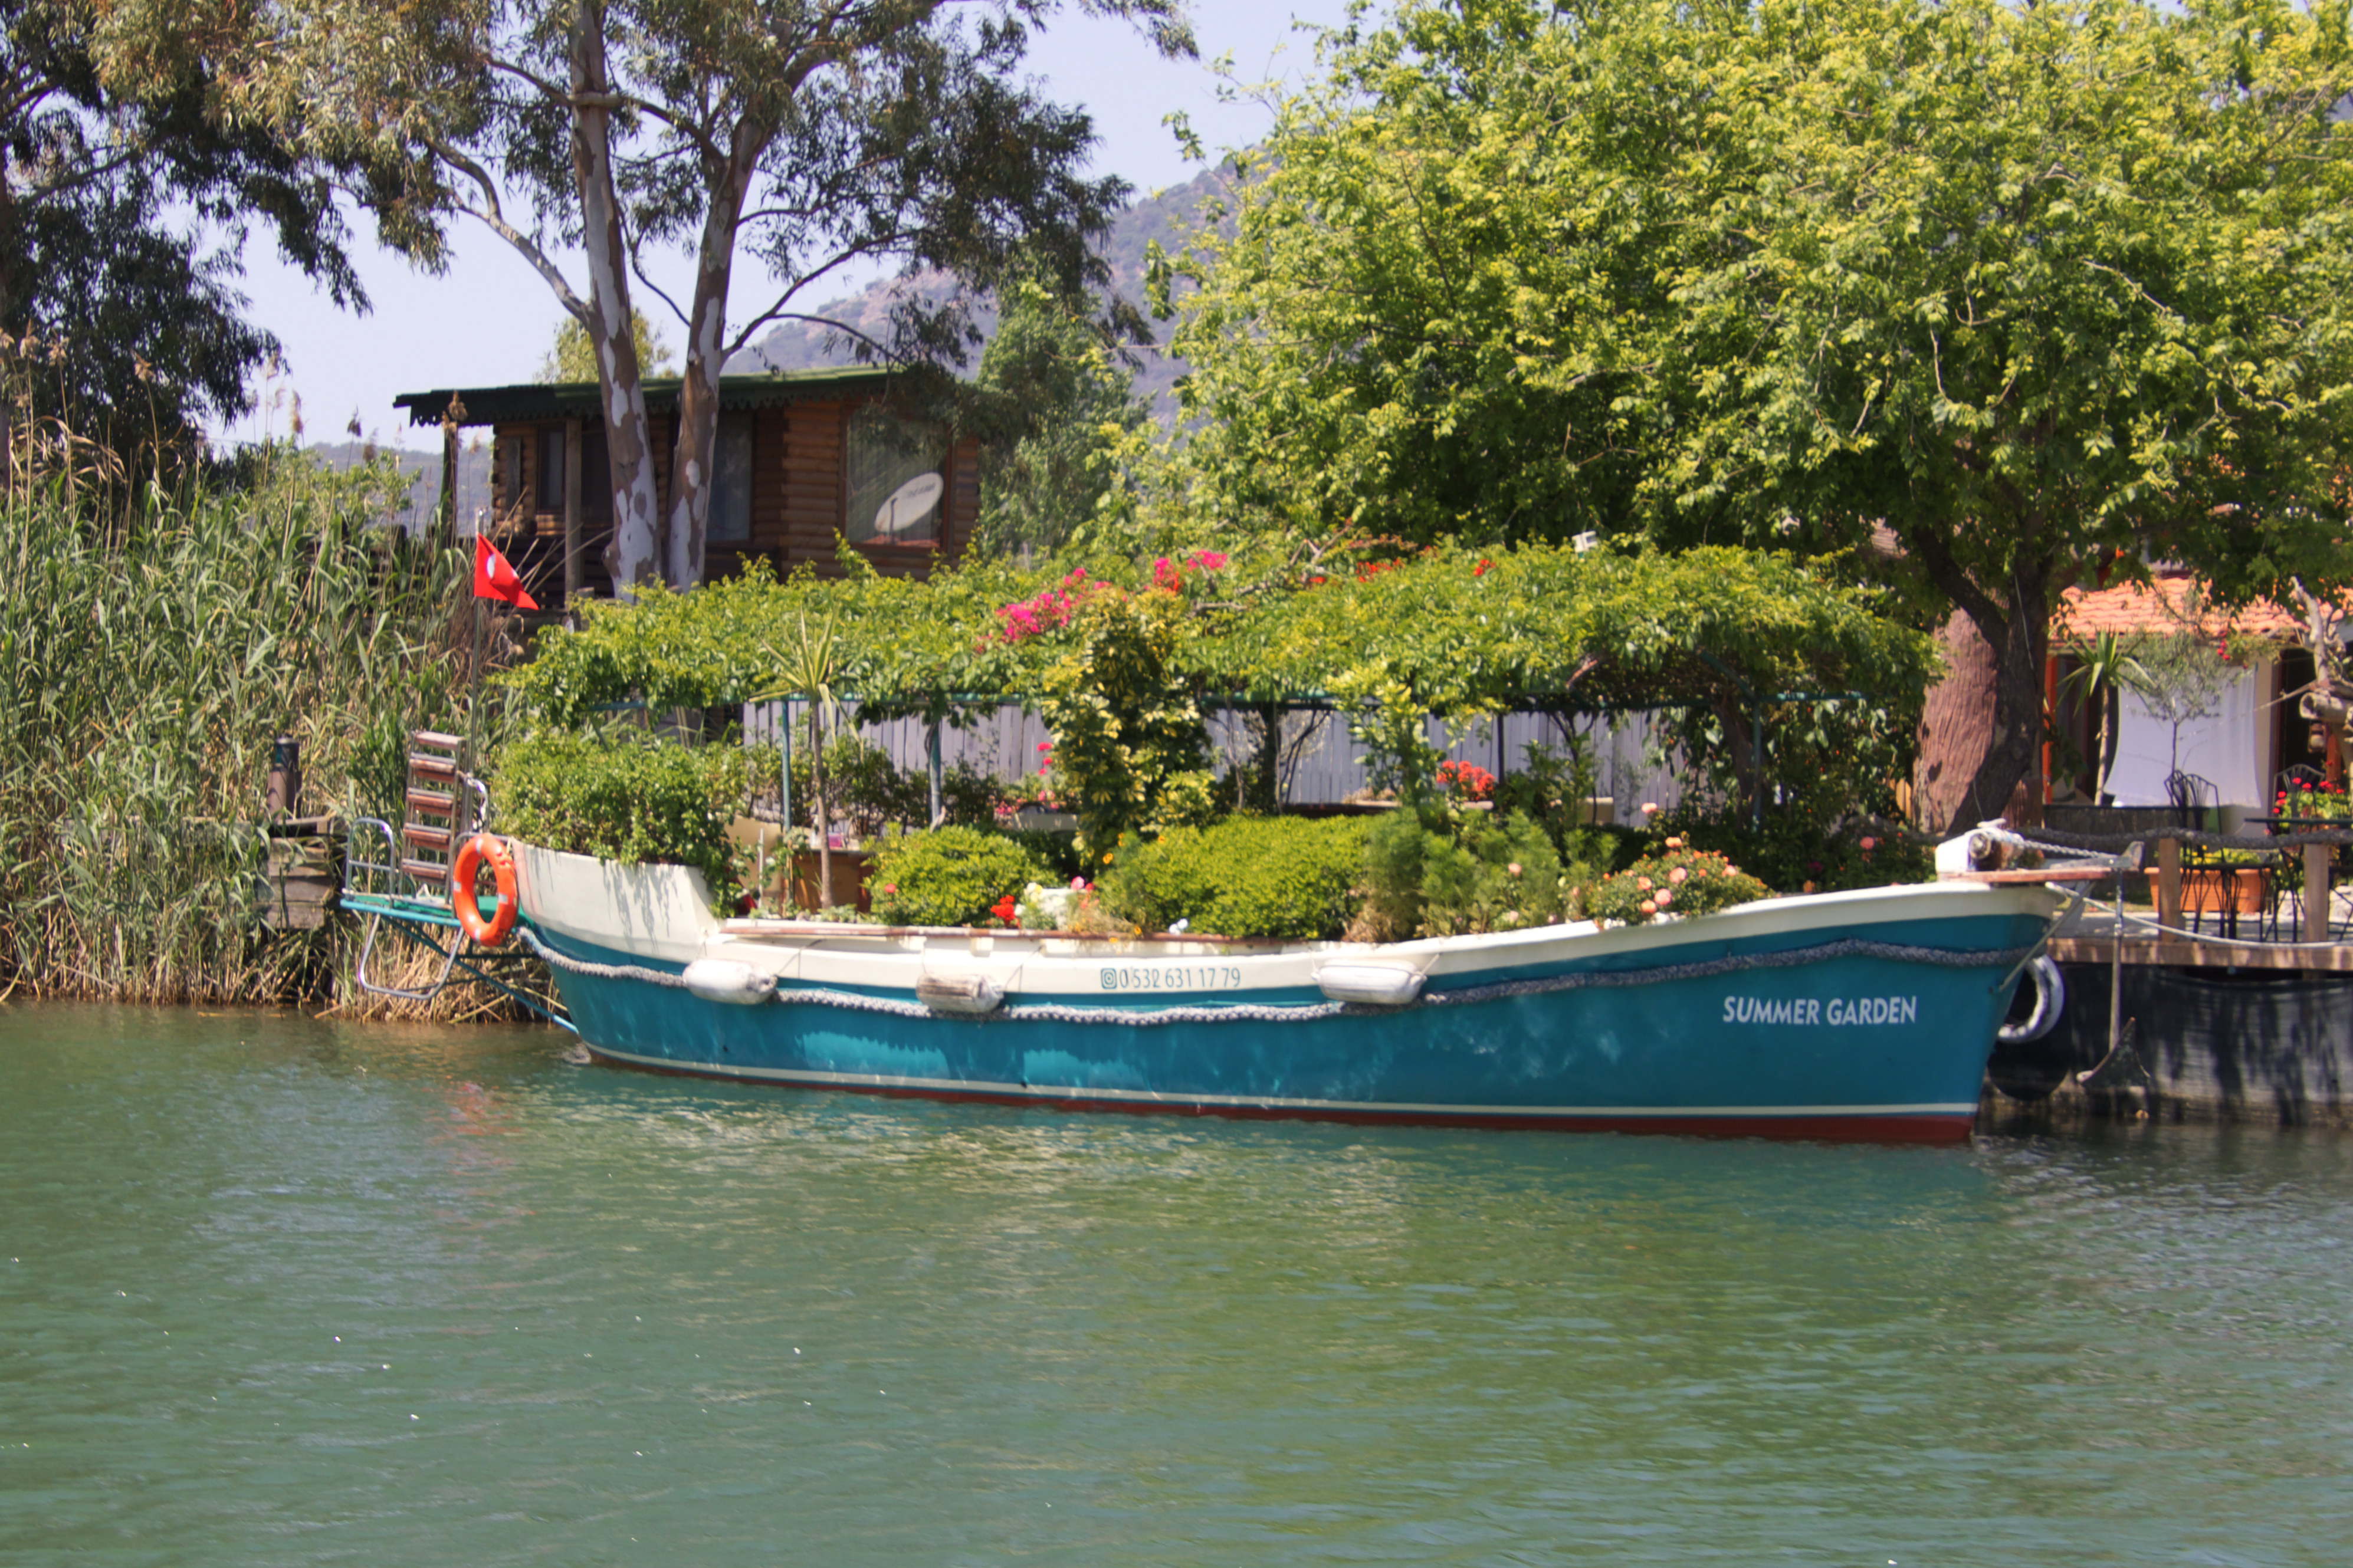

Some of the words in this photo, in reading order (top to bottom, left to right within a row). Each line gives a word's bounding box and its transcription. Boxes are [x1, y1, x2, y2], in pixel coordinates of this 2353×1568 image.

[1165, 968, 1192, 988] 631
[1198, 968, 1216, 987] 17
[1221, 967, 1241, 988] 79
[1722, 996, 1820, 1025] SUMMER
[1826, 995, 1917, 1025] GARDEN
